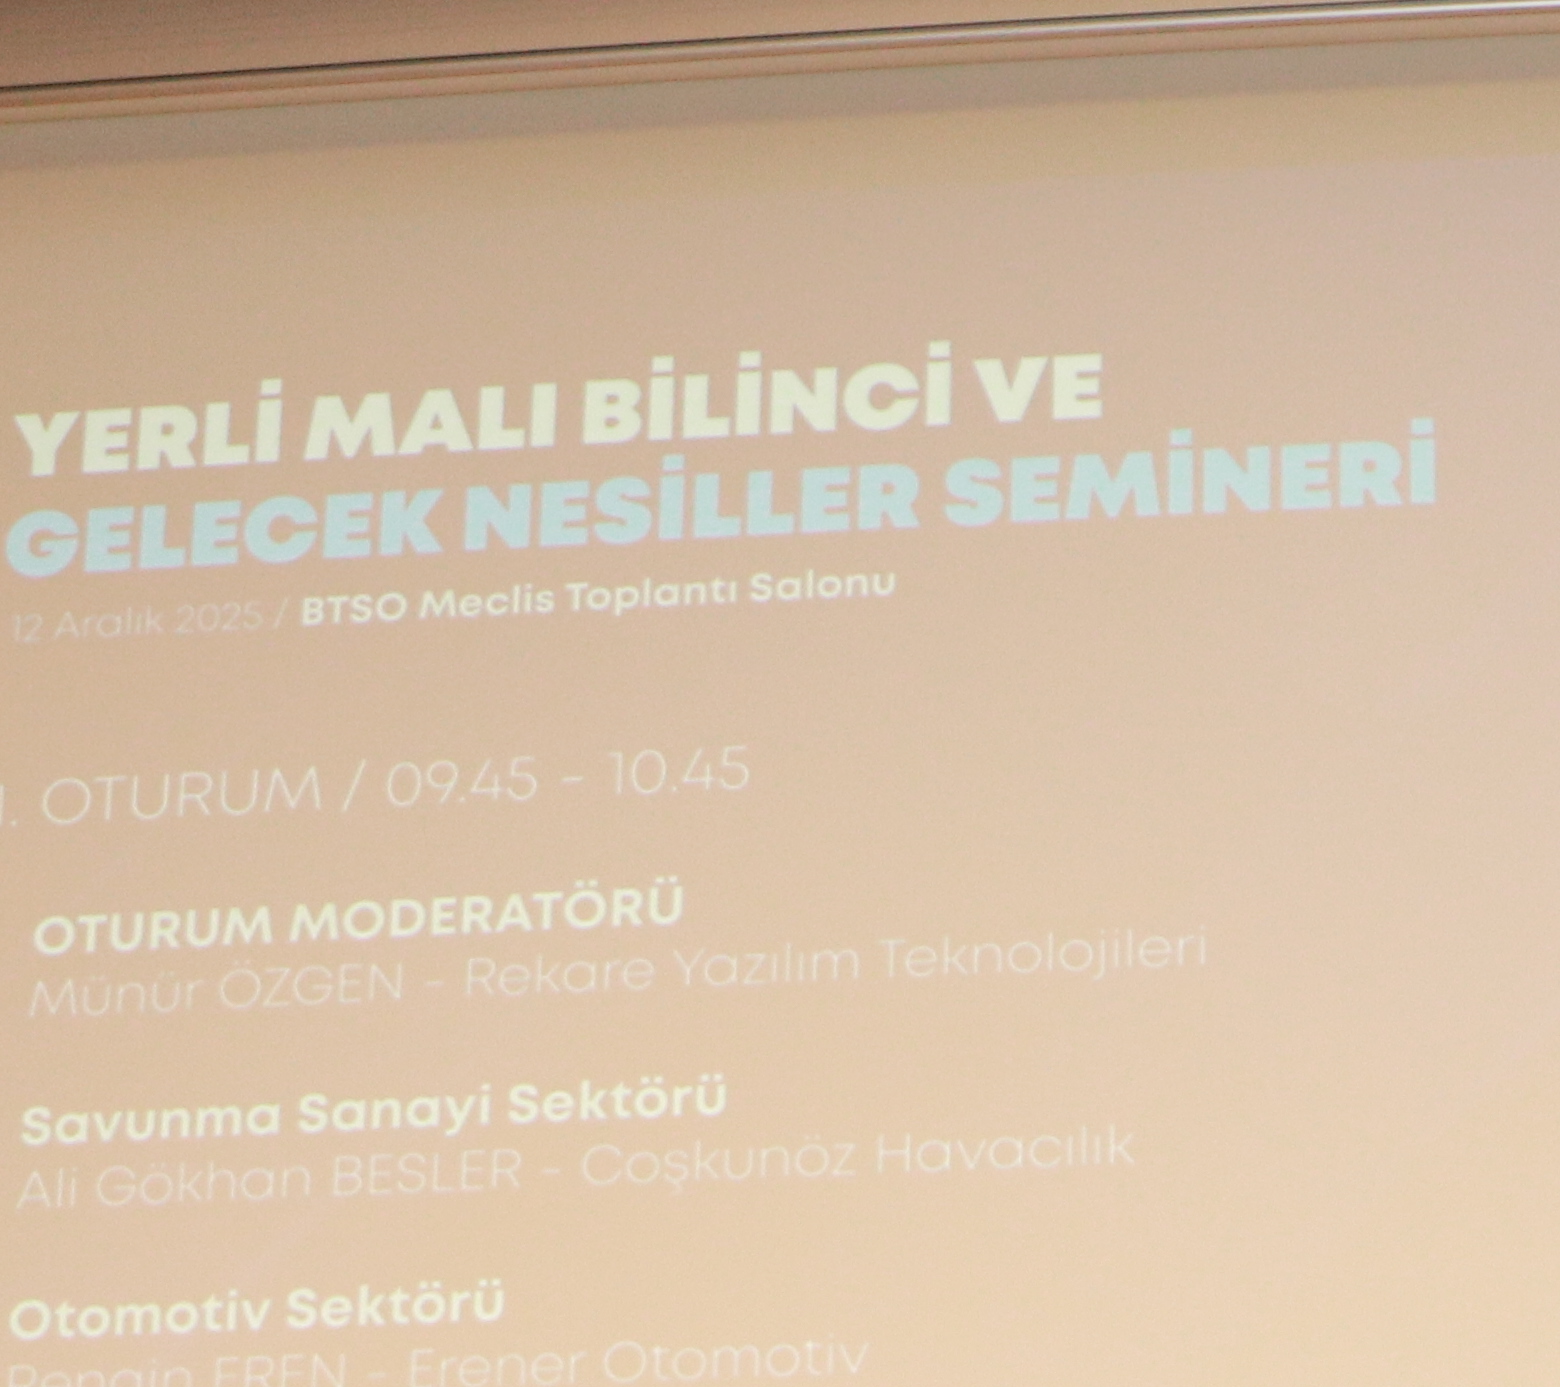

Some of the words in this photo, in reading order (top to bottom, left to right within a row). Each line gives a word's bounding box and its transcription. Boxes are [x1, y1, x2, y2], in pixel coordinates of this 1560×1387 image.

[13, 379, 284, 478] YERLİ
[304, 384, 558, 463] MALI
[582, 341, 952, 447] BİLİNCİ
[974, 354, 1104, 425] VE
[4, 488, 445, 579] GELECEK
[463, 455, 921, 553] NESİLLER
[944, 416, 1436, 529] SEMİNERİ
[300, 592, 408, 628] BTSO
[418, 582, 554, 621] Meclis
[565, 577, 737, 617] Toplantı
[747, 568, 897, 604] Salonu
[41, 766, 322, 826] OTURUM
[385, 755, 538, 808] 09.45
[606, 745, 750, 798] 10.45
[33, 907, 274, 958] OTURUM
[290, 875, 684, 943] MODERATÖRÜ
[217, 958, 405, 1012] ÖZGEN
[465, 953, 655, 1000] Rekare
[878, 924, 1208, 982] Teknolojileri
[20, 1103, 282, 1149] Savunma
[297, 1083, 493, 1138] Sanayi
[507, 1072, 728, 1126] Sektörü
[15, 1166, 79, 1215] Ali
[93, 1161, 312, 1211] Gökhan
[331, 1147, 524, 1198] BESLER
[580, 1135, 858, 1193] Coşkunöz
[875, 1125, 1137, 1176] Havacılık
[8, 1289, 271, 1343] Otomotiv
[284, 1277, 506, 1330] Sektörü
[602, 1333, 870, 1385] Otomotiv
